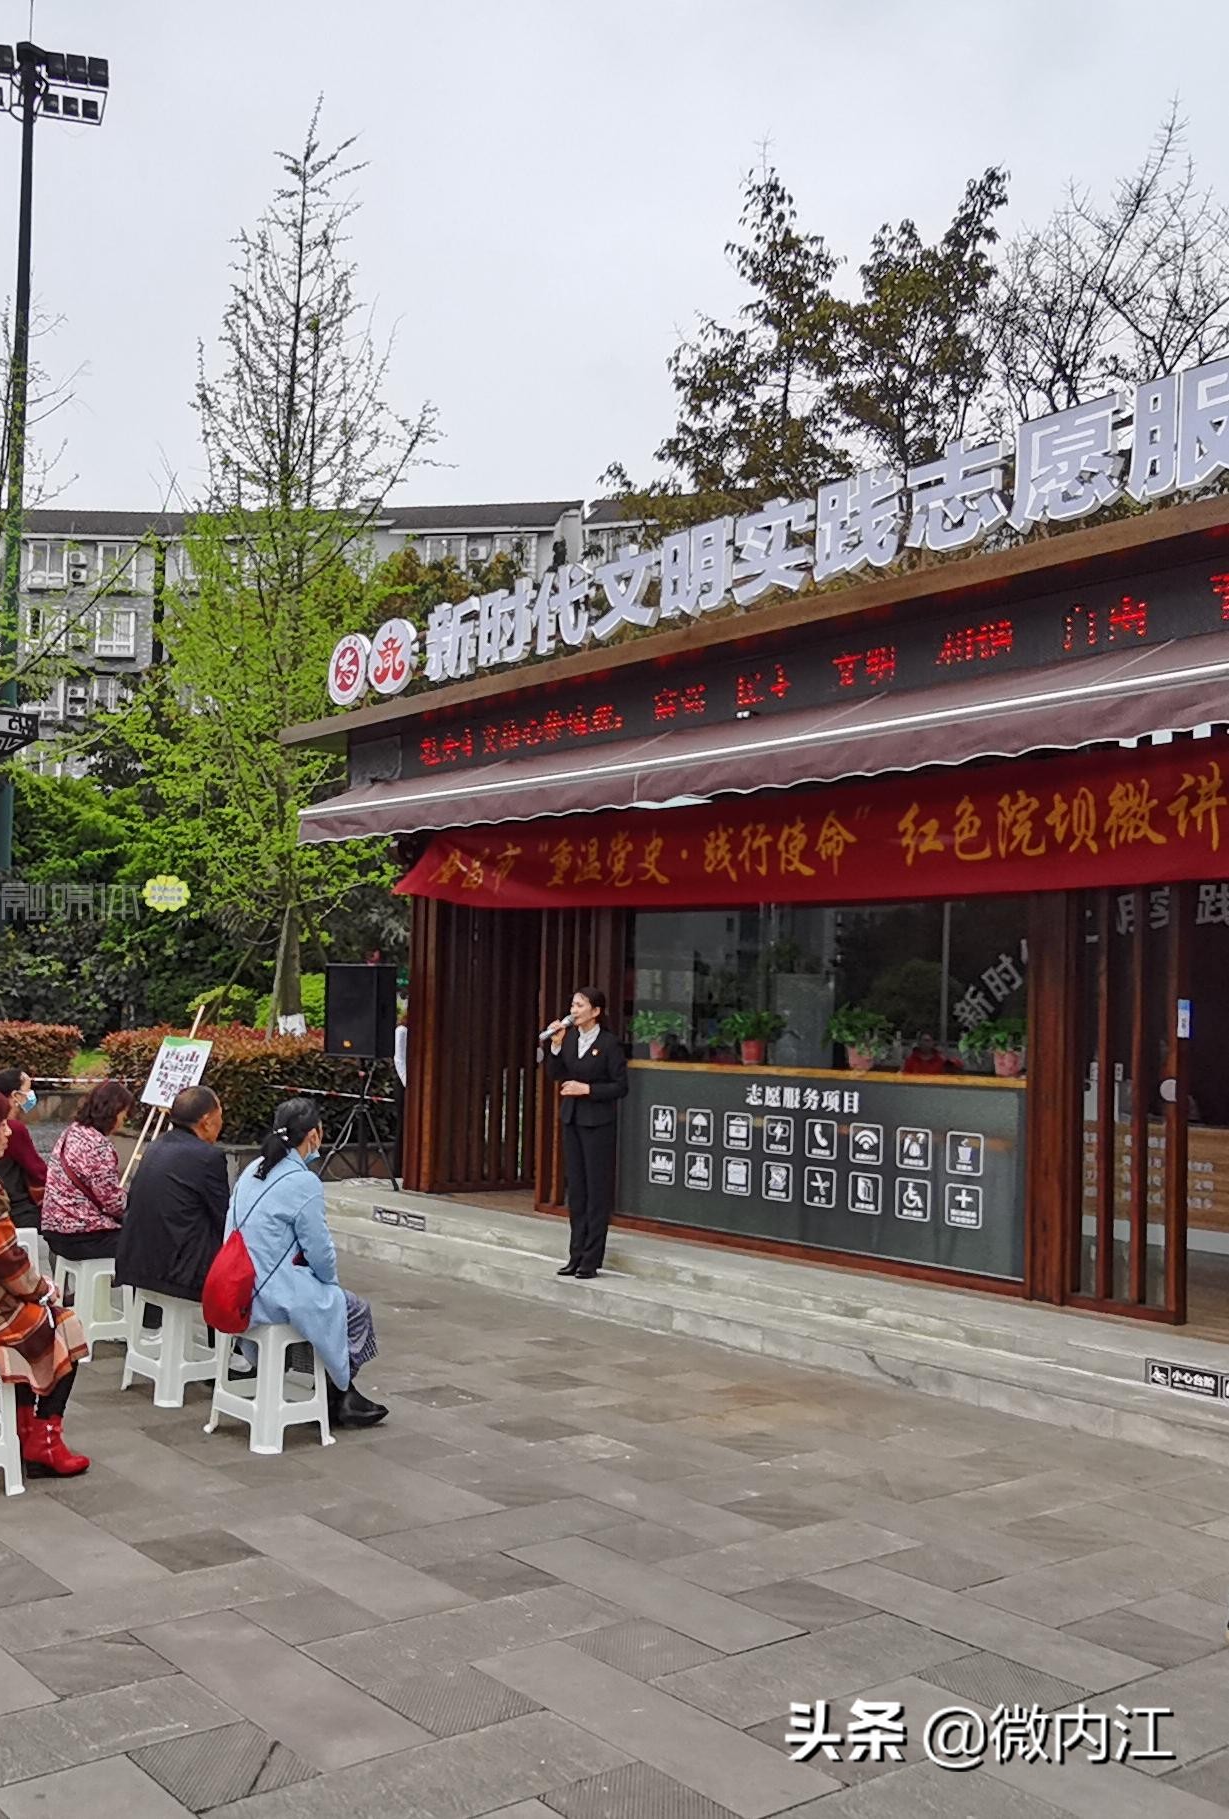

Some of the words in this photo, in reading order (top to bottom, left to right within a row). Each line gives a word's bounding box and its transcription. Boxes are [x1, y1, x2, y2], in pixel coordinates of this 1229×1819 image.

[745, 1083, 860, 1114] 志愿服务项目
